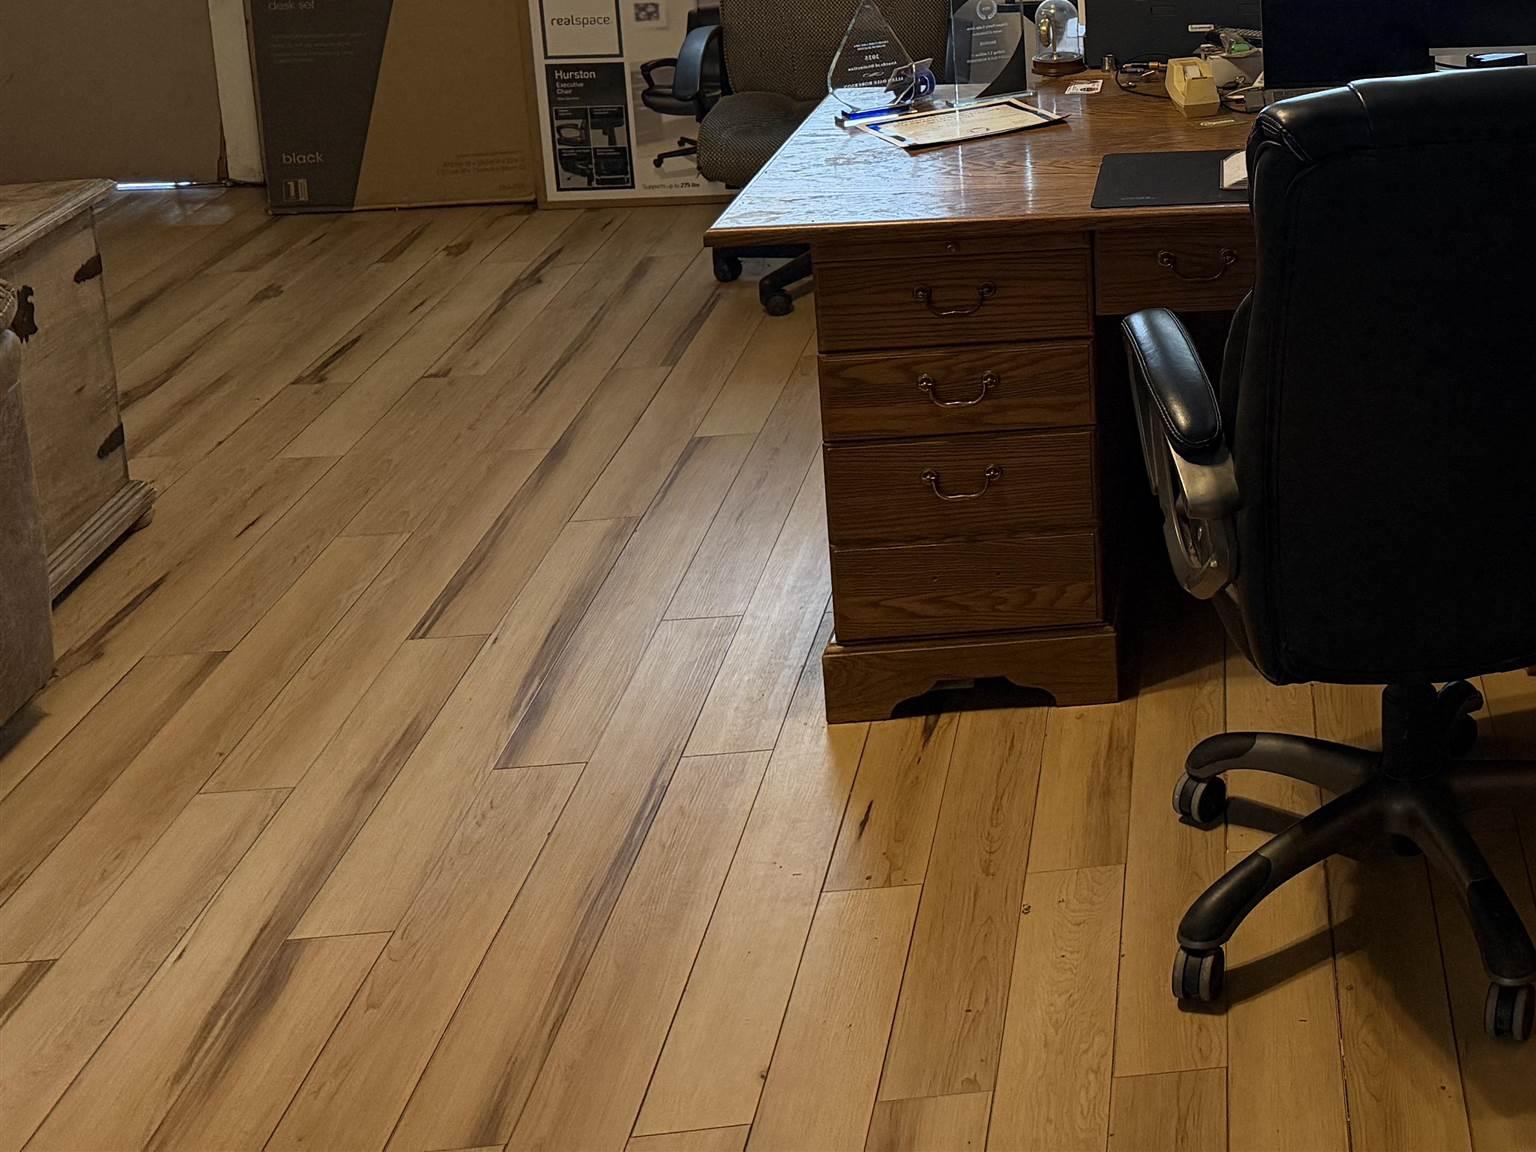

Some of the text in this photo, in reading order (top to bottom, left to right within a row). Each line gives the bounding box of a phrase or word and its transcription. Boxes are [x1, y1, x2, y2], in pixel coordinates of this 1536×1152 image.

[550, 14, 611, 28] realspace
[554, 69, 596, 80] Hurston
[556, 81, 585, 89] Executive
[282, 151, 325, 164] black
